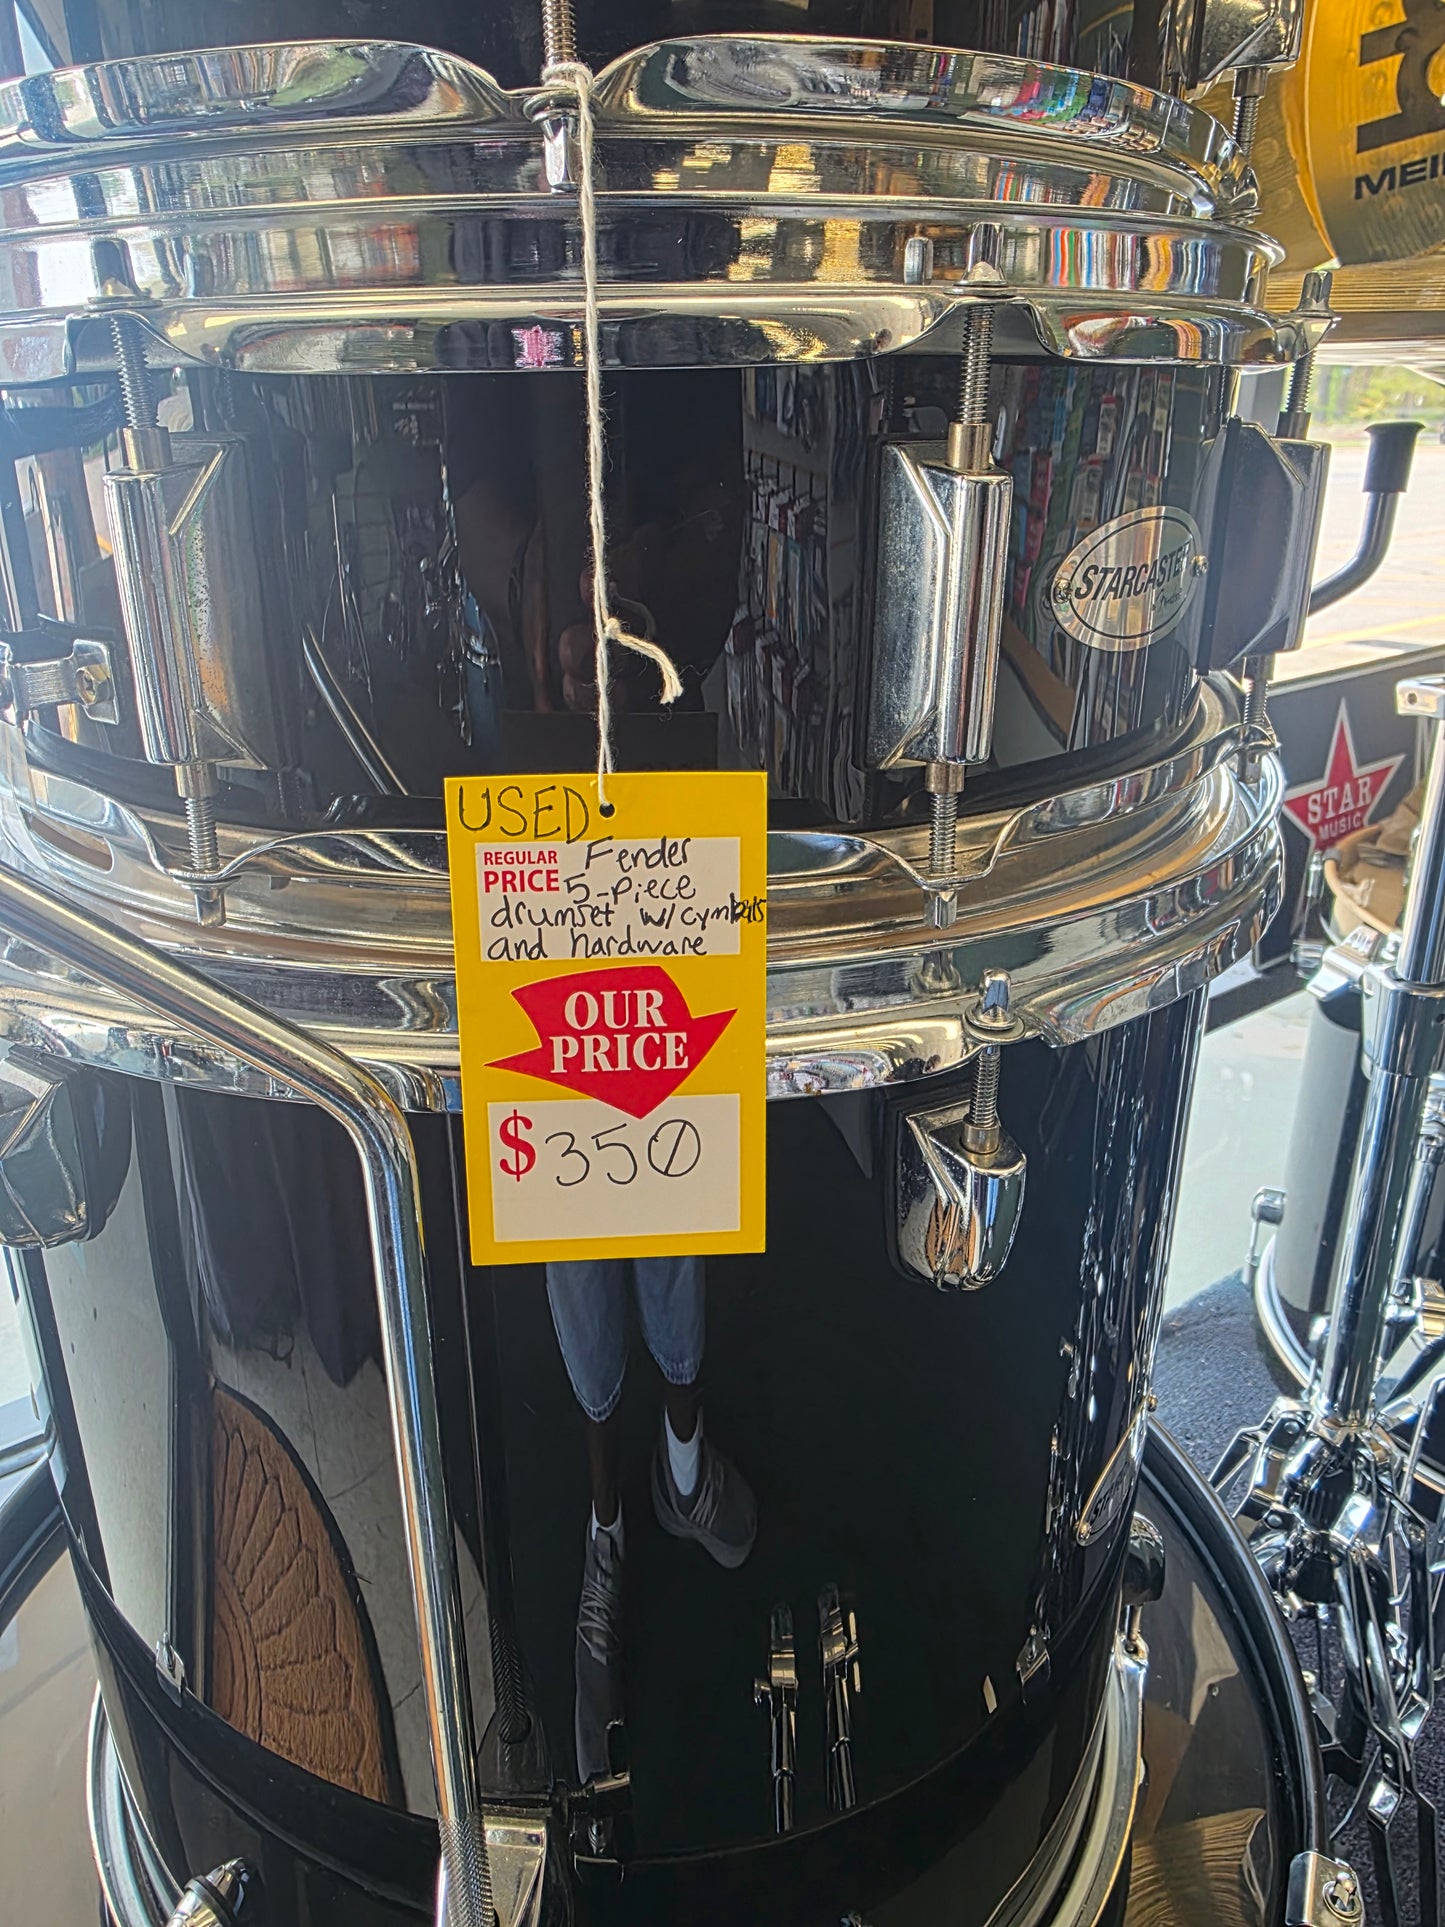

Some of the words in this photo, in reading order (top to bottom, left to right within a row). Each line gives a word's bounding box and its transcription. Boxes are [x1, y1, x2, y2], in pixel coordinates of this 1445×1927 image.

[1354, 151, 1445, 200] MEI
[458, 785, 590, 844] USED
[1307, 777, 1372, 824] STAR
[1318, 811, 1363, 841] MUSIC
[483, 850, 558, 866] REGULAR
[585, 835, 692, 870] Fender
[484, 869, 560, 893] PRICE
[487, 928, 548, 961] and
[570, 925, 708, 959] hardware
[564, 989, 668, 1031] OUR
[549, 1031, 689, 1074] PRICE
